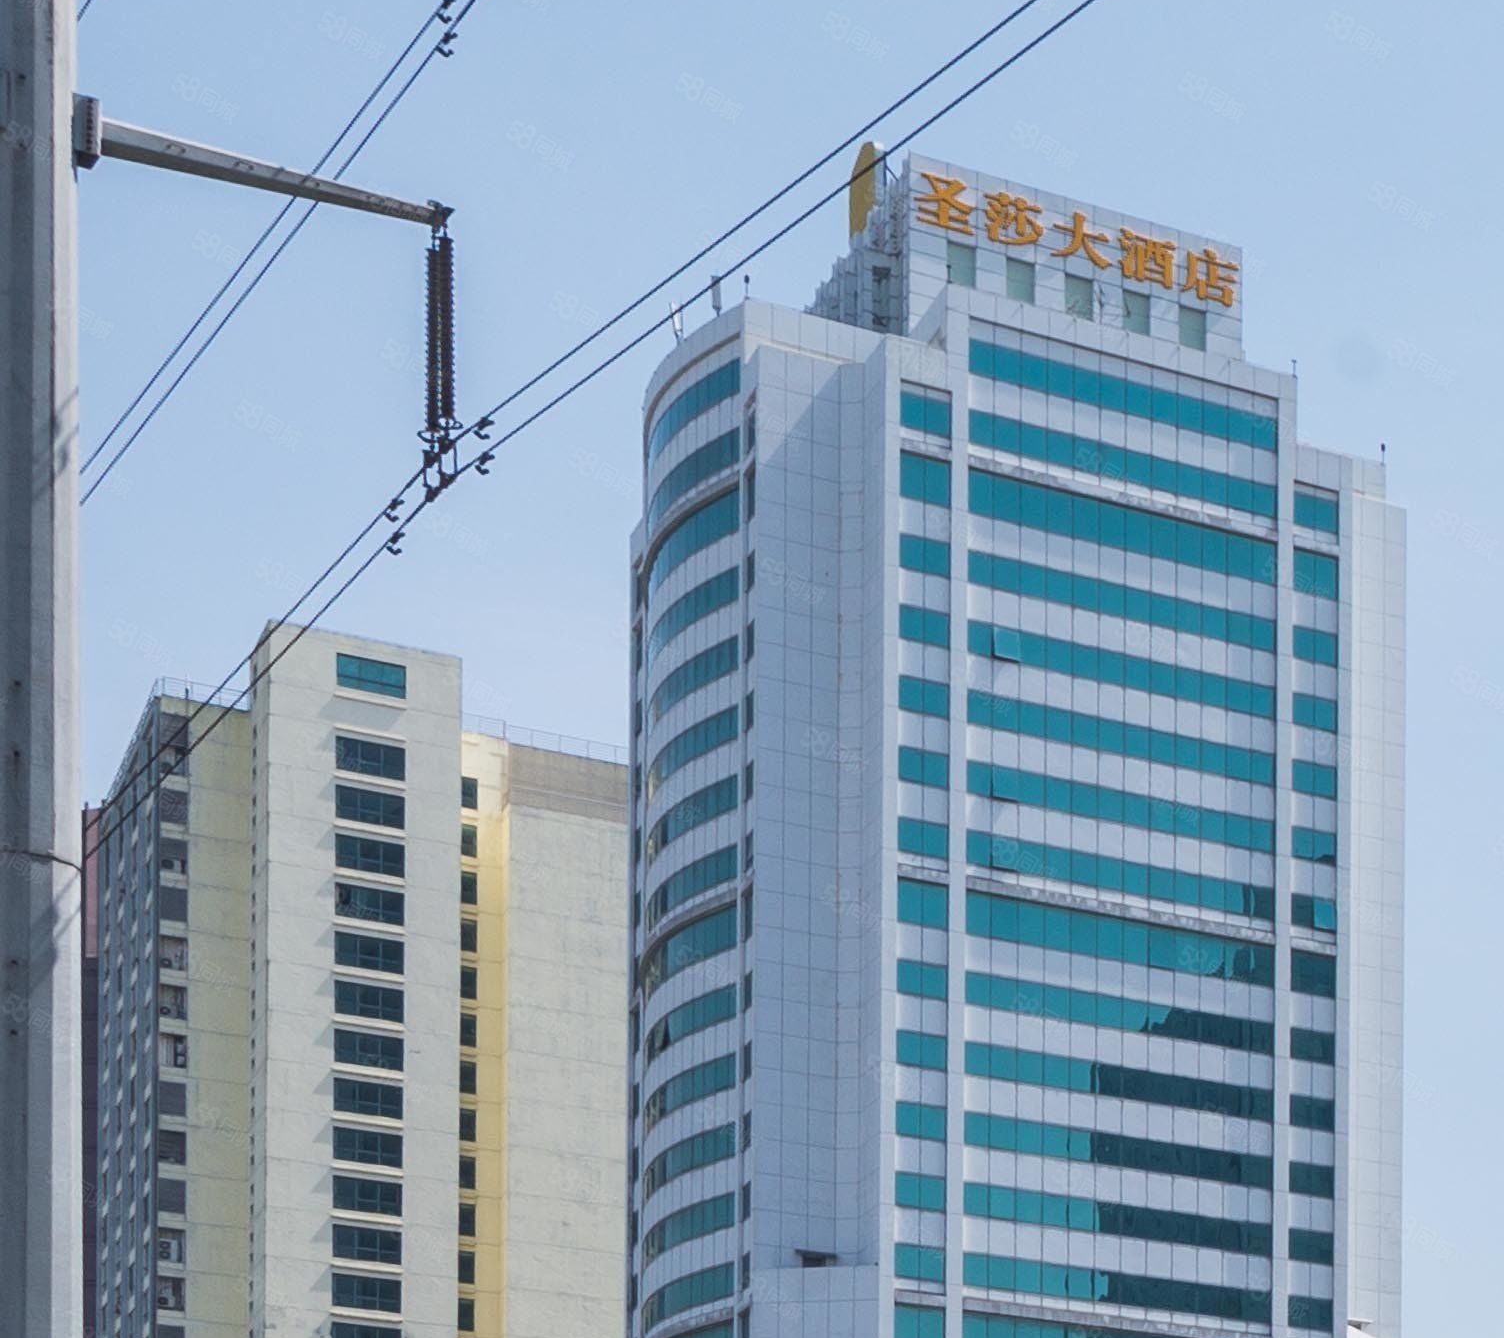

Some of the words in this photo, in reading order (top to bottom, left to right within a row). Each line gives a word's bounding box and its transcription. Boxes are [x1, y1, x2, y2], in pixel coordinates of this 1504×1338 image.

[914, 172, 1240, 308] 圣莎大酒店
